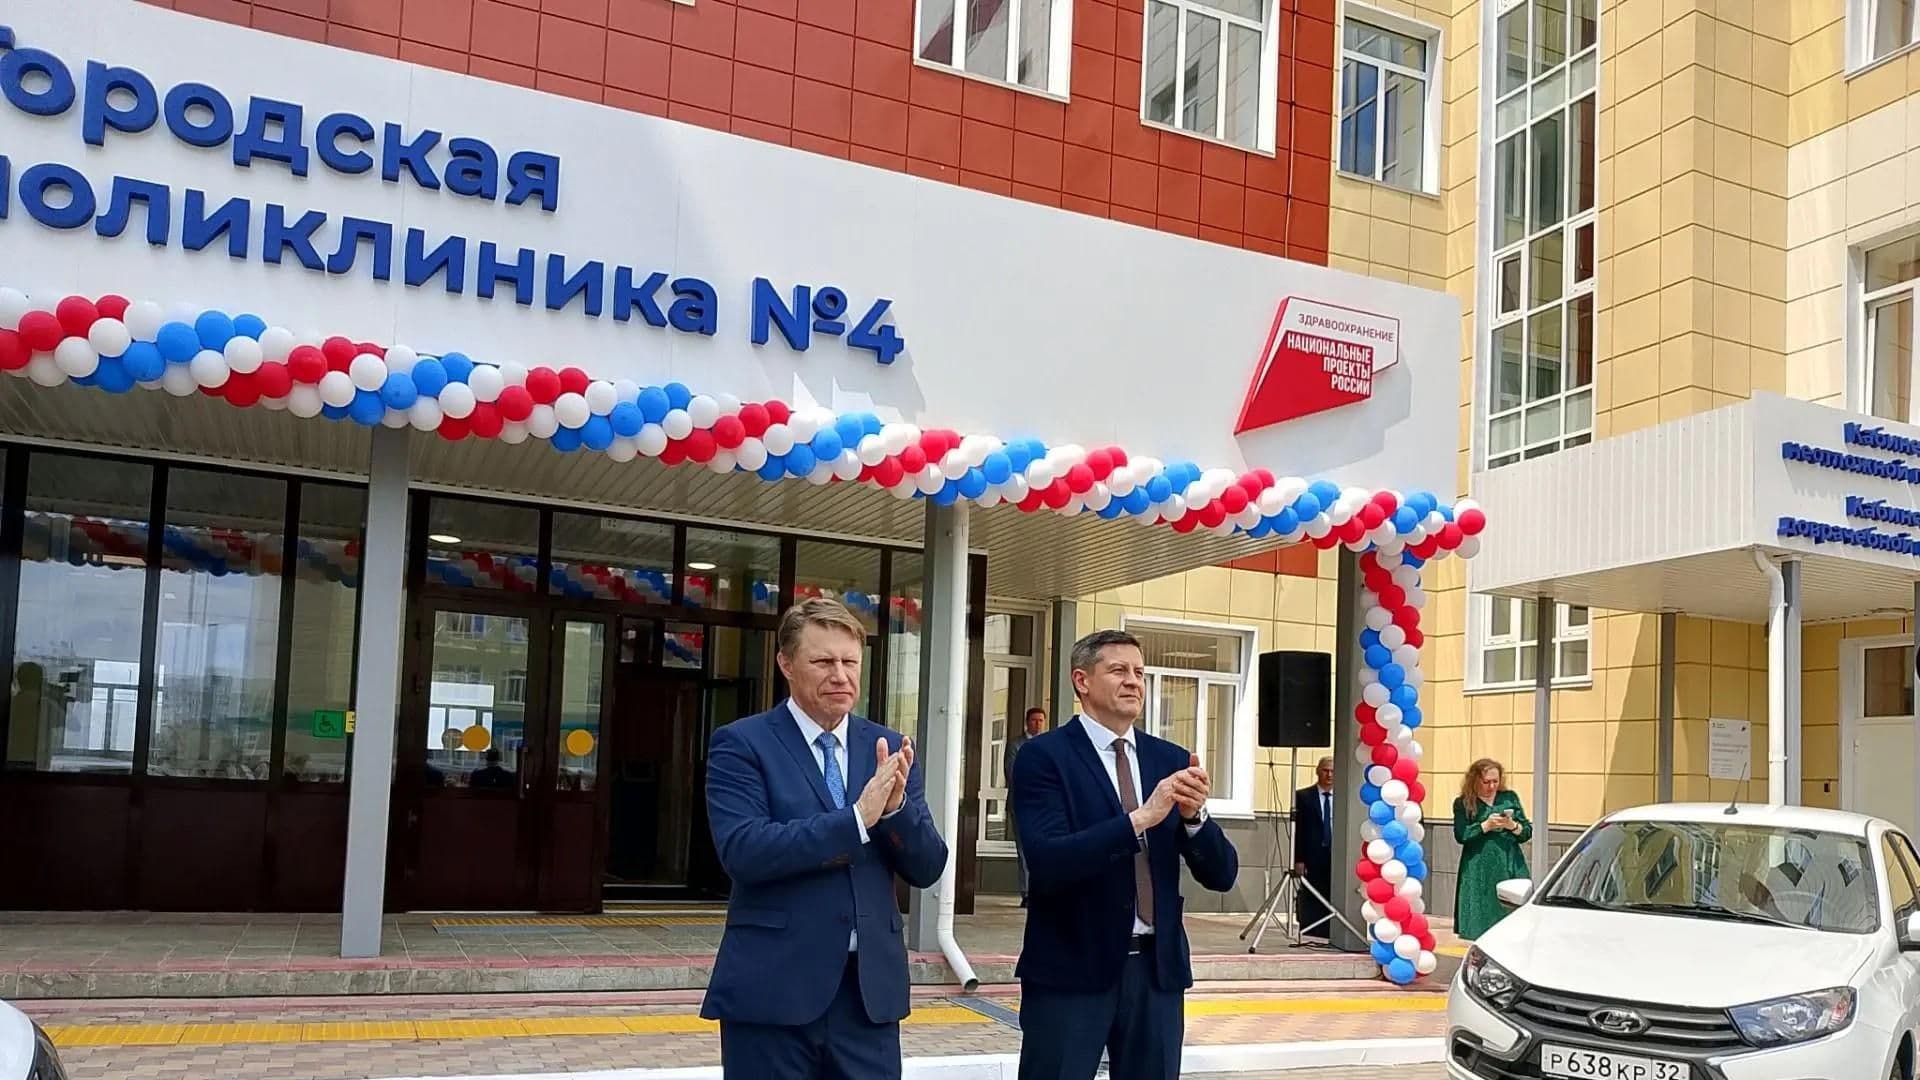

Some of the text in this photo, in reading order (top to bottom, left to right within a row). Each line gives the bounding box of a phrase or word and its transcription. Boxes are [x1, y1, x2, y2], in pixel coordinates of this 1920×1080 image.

[0, 25, 559, 212] ородская
[750, 276, 904, 365] №4
[1298, 313, 1394, 342] ЗДРАВООХРАНЕНИЕ
[1287, 332, 1372, 364] НАЦИОНАЛЬНЫЕ
[1323, 357, 1371, 378] ПРОЕКТЫ
[1331, 375, 1370, 395] РОССИИ
[1782, 441, 1908, 481] неотложной
